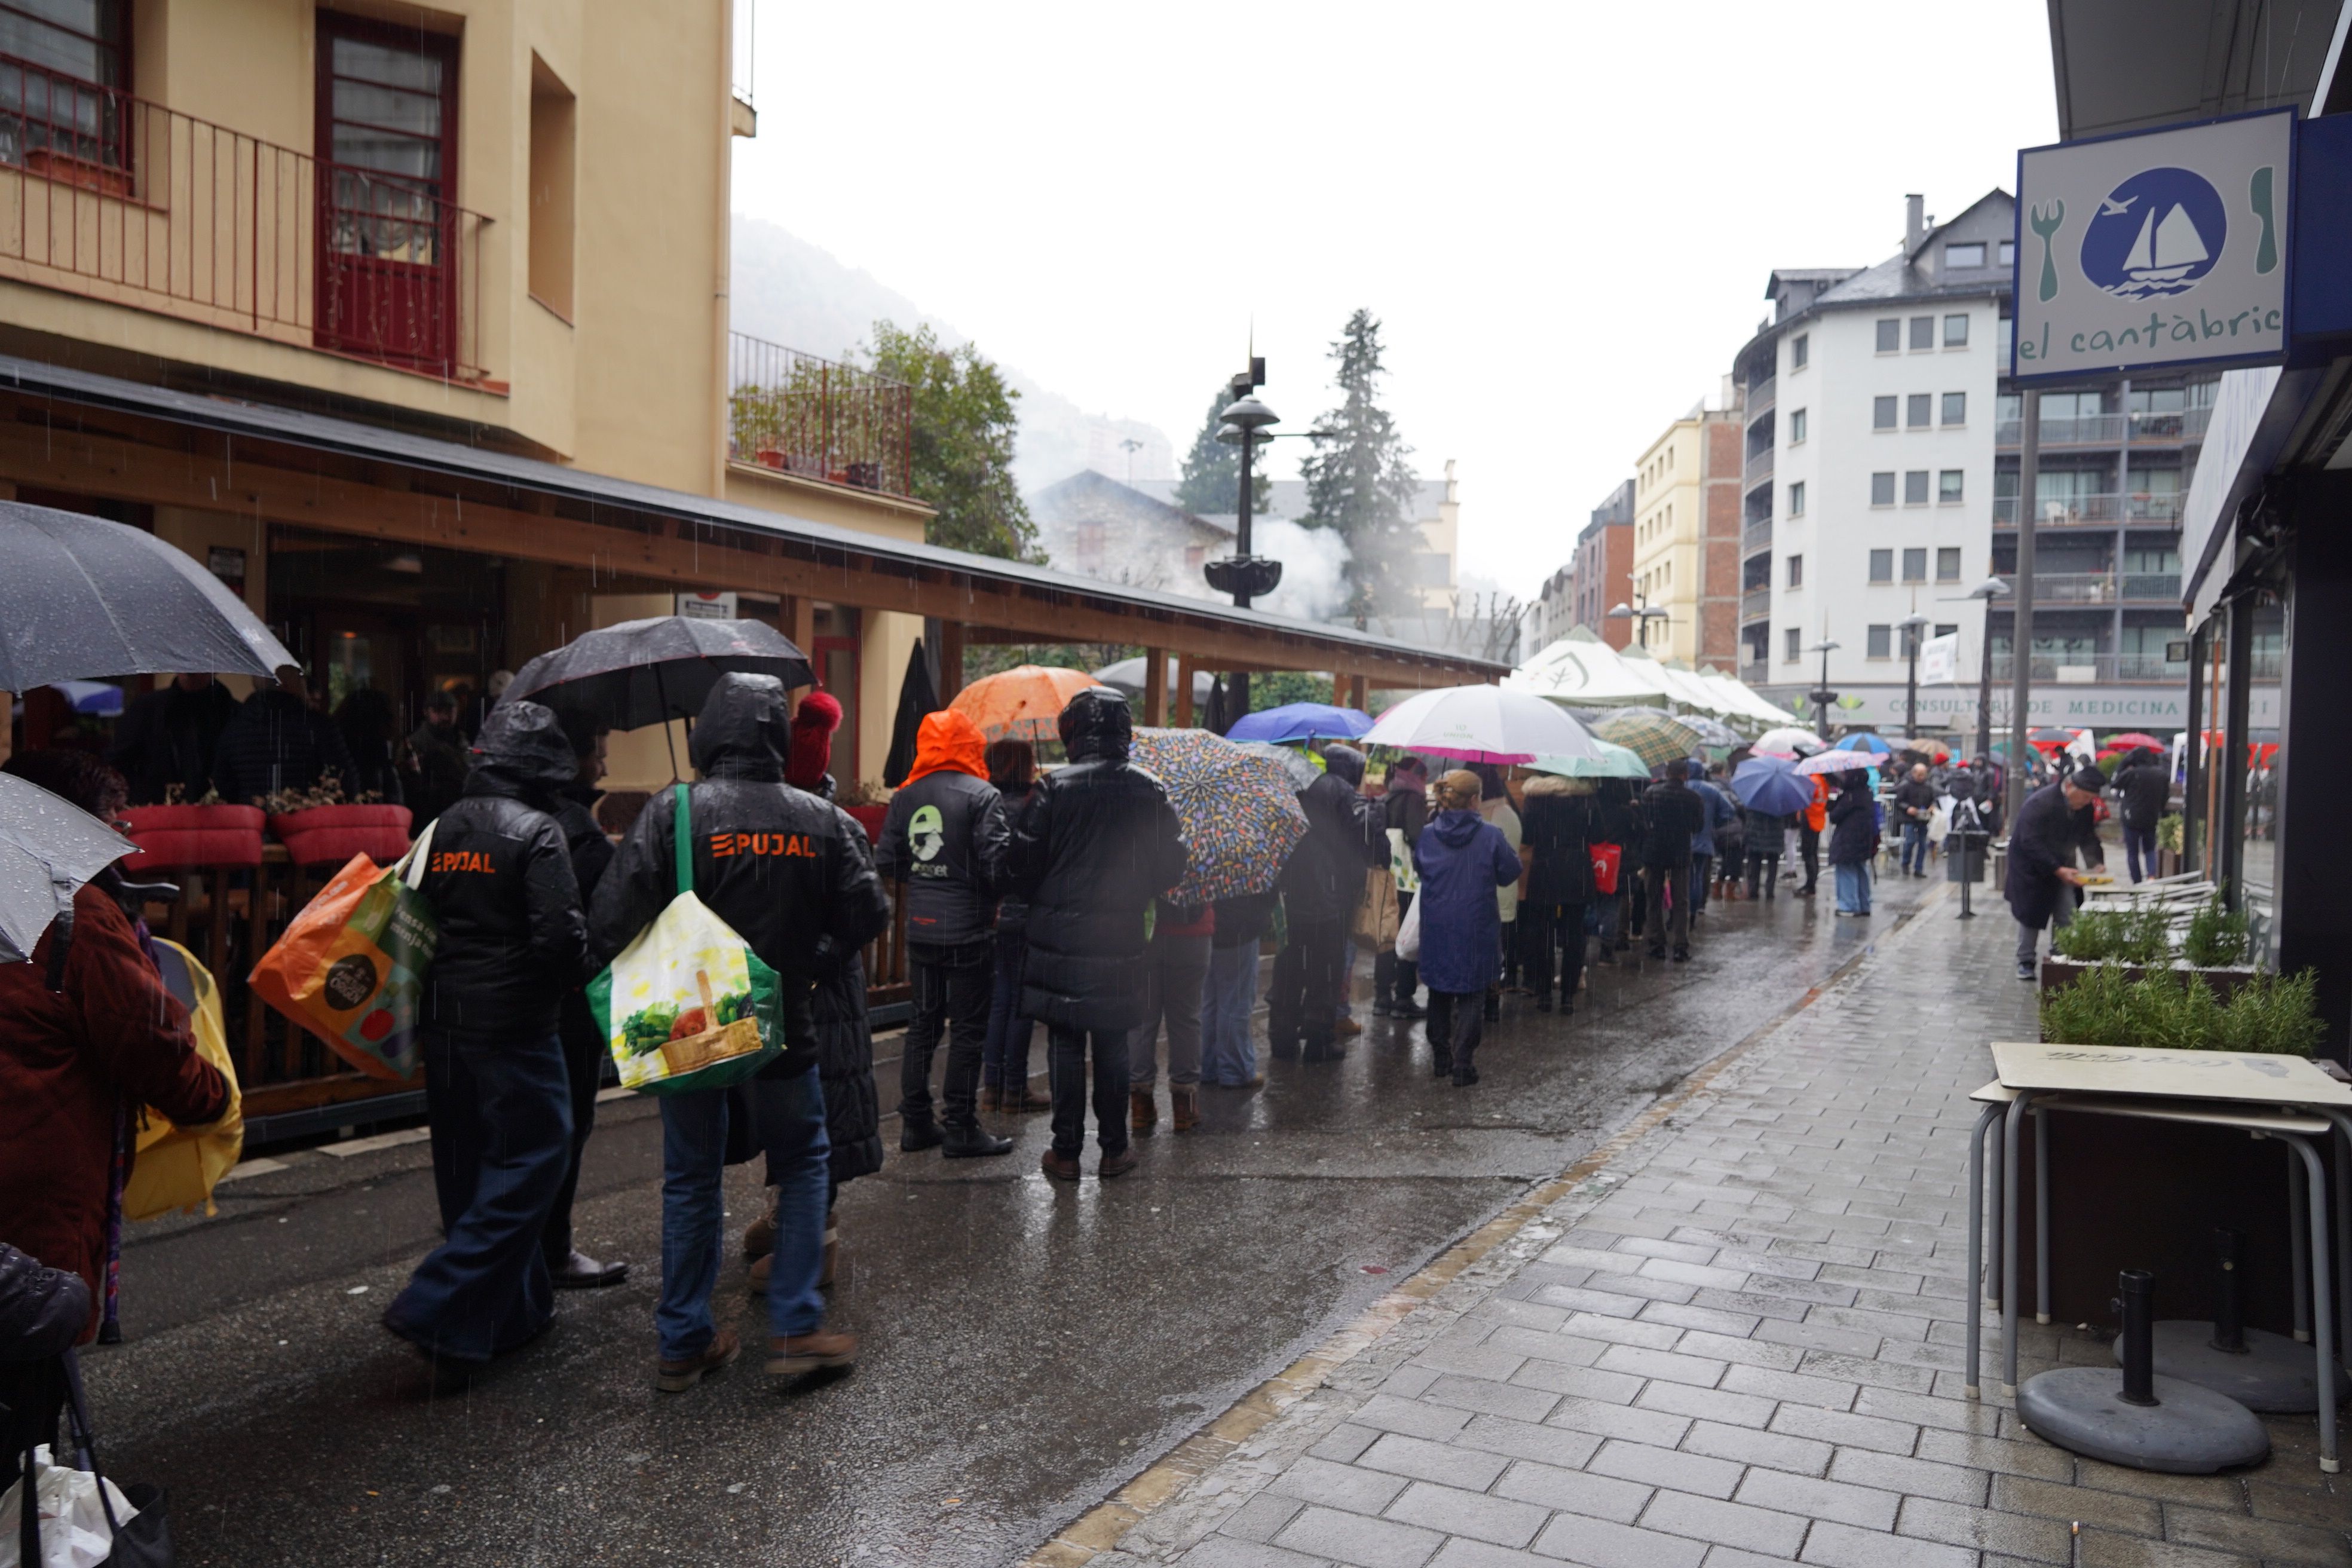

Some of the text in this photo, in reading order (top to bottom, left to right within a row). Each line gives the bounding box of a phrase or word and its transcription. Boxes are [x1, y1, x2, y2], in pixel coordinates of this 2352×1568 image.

[2019, 305, 2282, 360] el cantàbric
[1889, 699, 2178, 715] CONSULTRI DE MEDICINA
